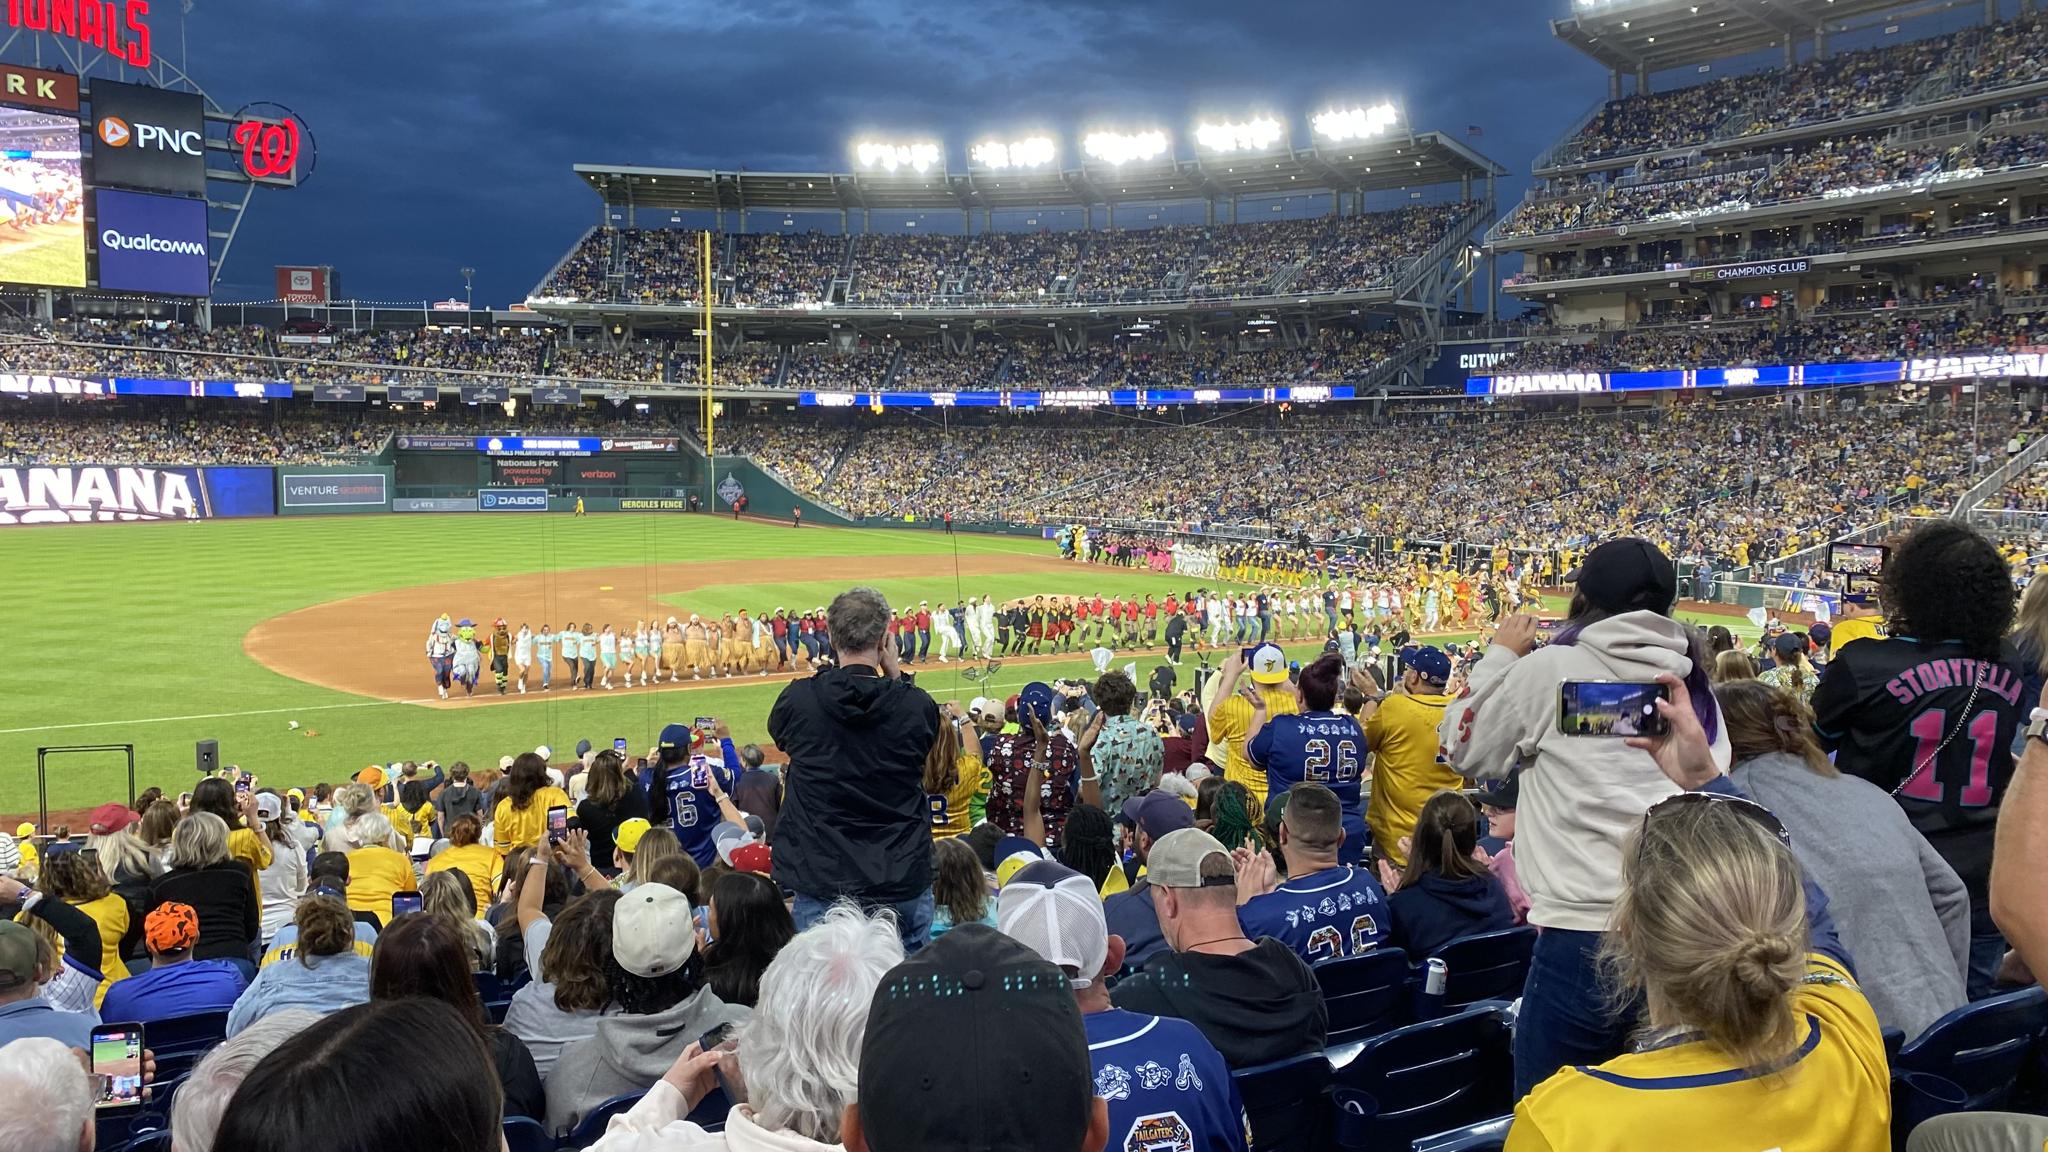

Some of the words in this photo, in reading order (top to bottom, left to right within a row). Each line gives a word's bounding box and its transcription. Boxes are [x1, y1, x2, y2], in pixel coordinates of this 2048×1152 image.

[134, 123, 202, 155] PNC
[103, 230, 205, 255] Qualcomm
[1717, 264, 1777, 279] CHAMPIONS
[1778, 261, 1807, 273] CLUB
[503, 467, 540, 476] powered
[541, 467, 552, 476] by
[581, 469, 616, 479] verizon
[512, 476, 545, 485] Verizon
[290, 486, 338, 495] VENTURE
[498, 496, 545, 505] DABOS
[622, 500, 659, 508] HERCULES
[660, 500, 683, 508] FENCE
[1886, 658, 2023, 706] STORYTELLA
[1304, 739, 1358, 784] 26
[1901, 708, 1998, 806] 11
[1134, 1126, 1175, 1143] TAILGATERS
